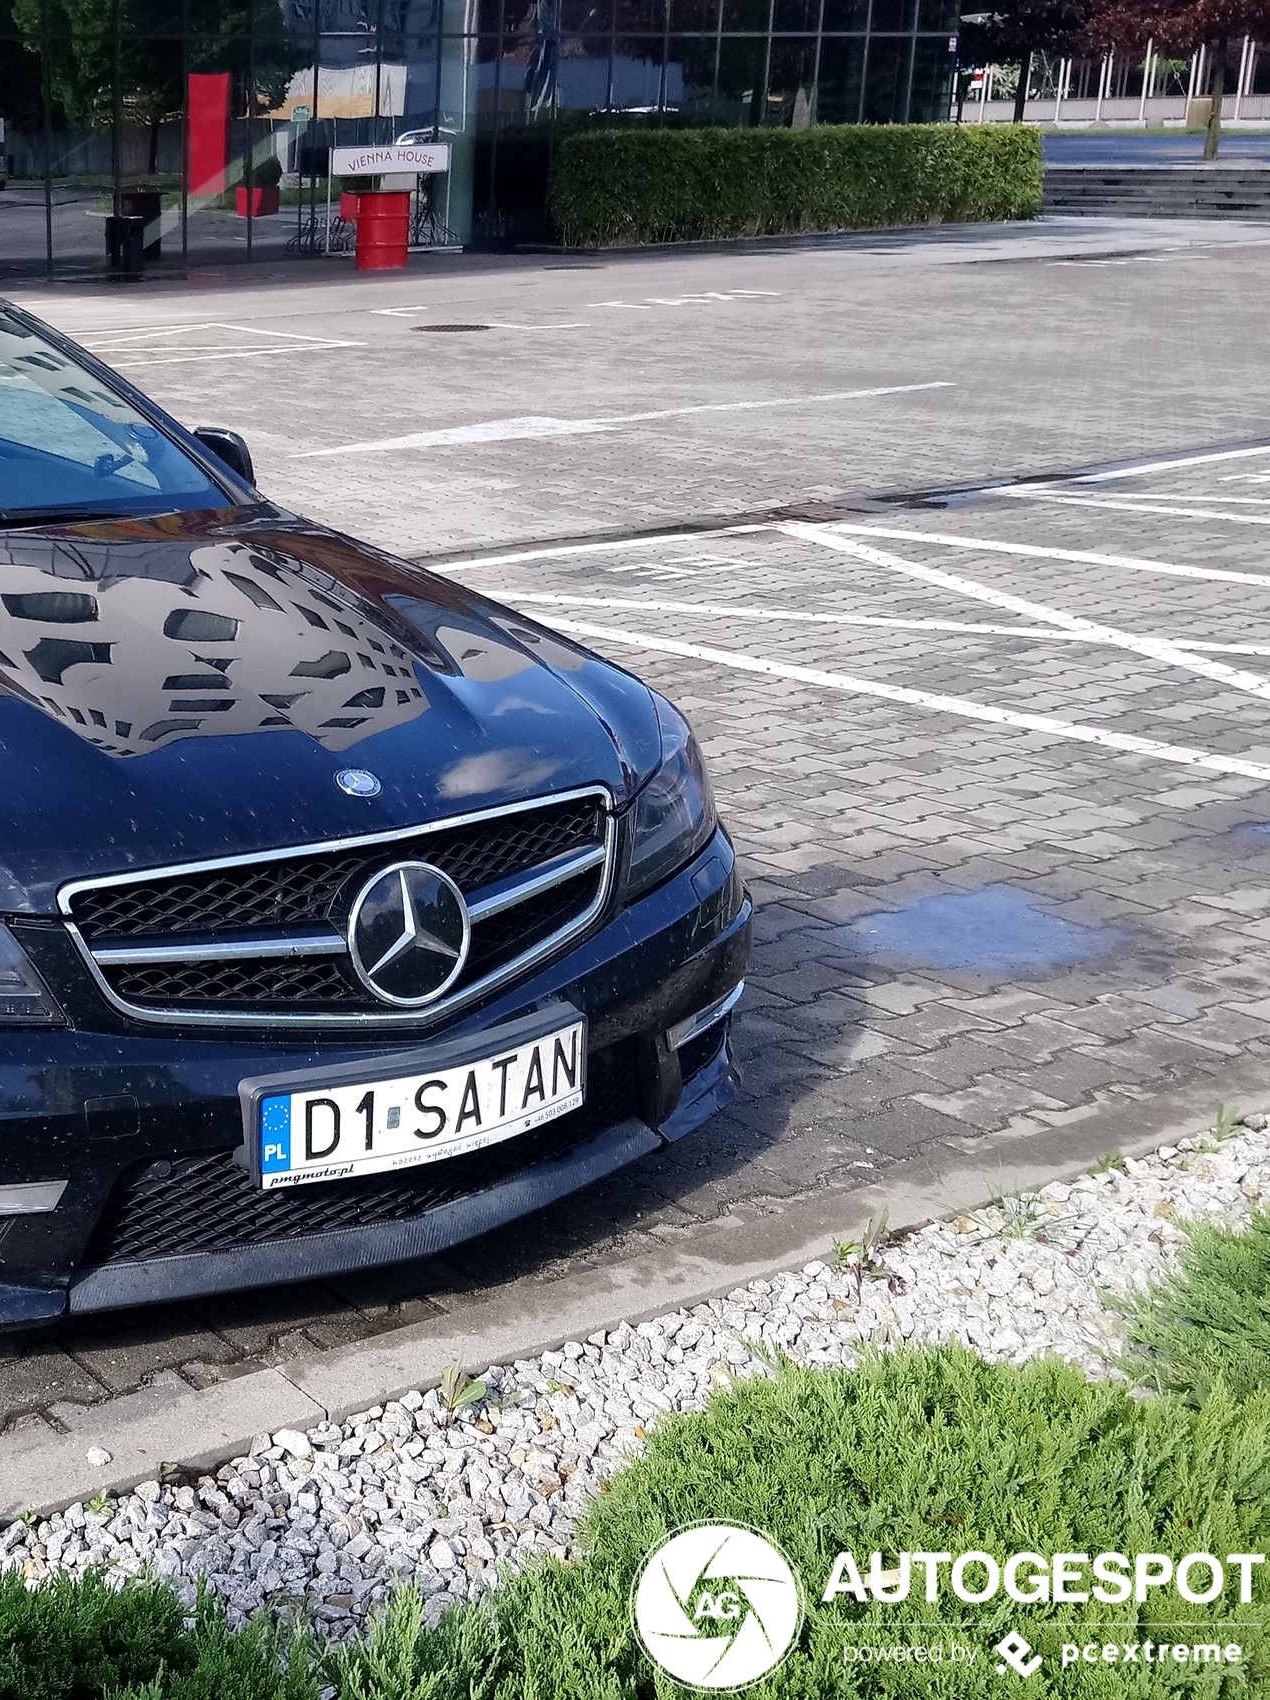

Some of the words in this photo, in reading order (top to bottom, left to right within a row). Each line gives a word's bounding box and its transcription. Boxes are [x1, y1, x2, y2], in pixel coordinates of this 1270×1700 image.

[348, 151, 392, 172] VIENNA
[397, 150, 434, 168] HOUSE
[305, 1090, 374, 1161] D1
[413, 1030, 577, 1140] SATAN
[545, 1108, 556, 1119] 503
[569, 1096, 579, 1107] 129
[264, 1142, 287, 1162] PL
[270, 1164, 354, 1187] pmgmoto.pl
